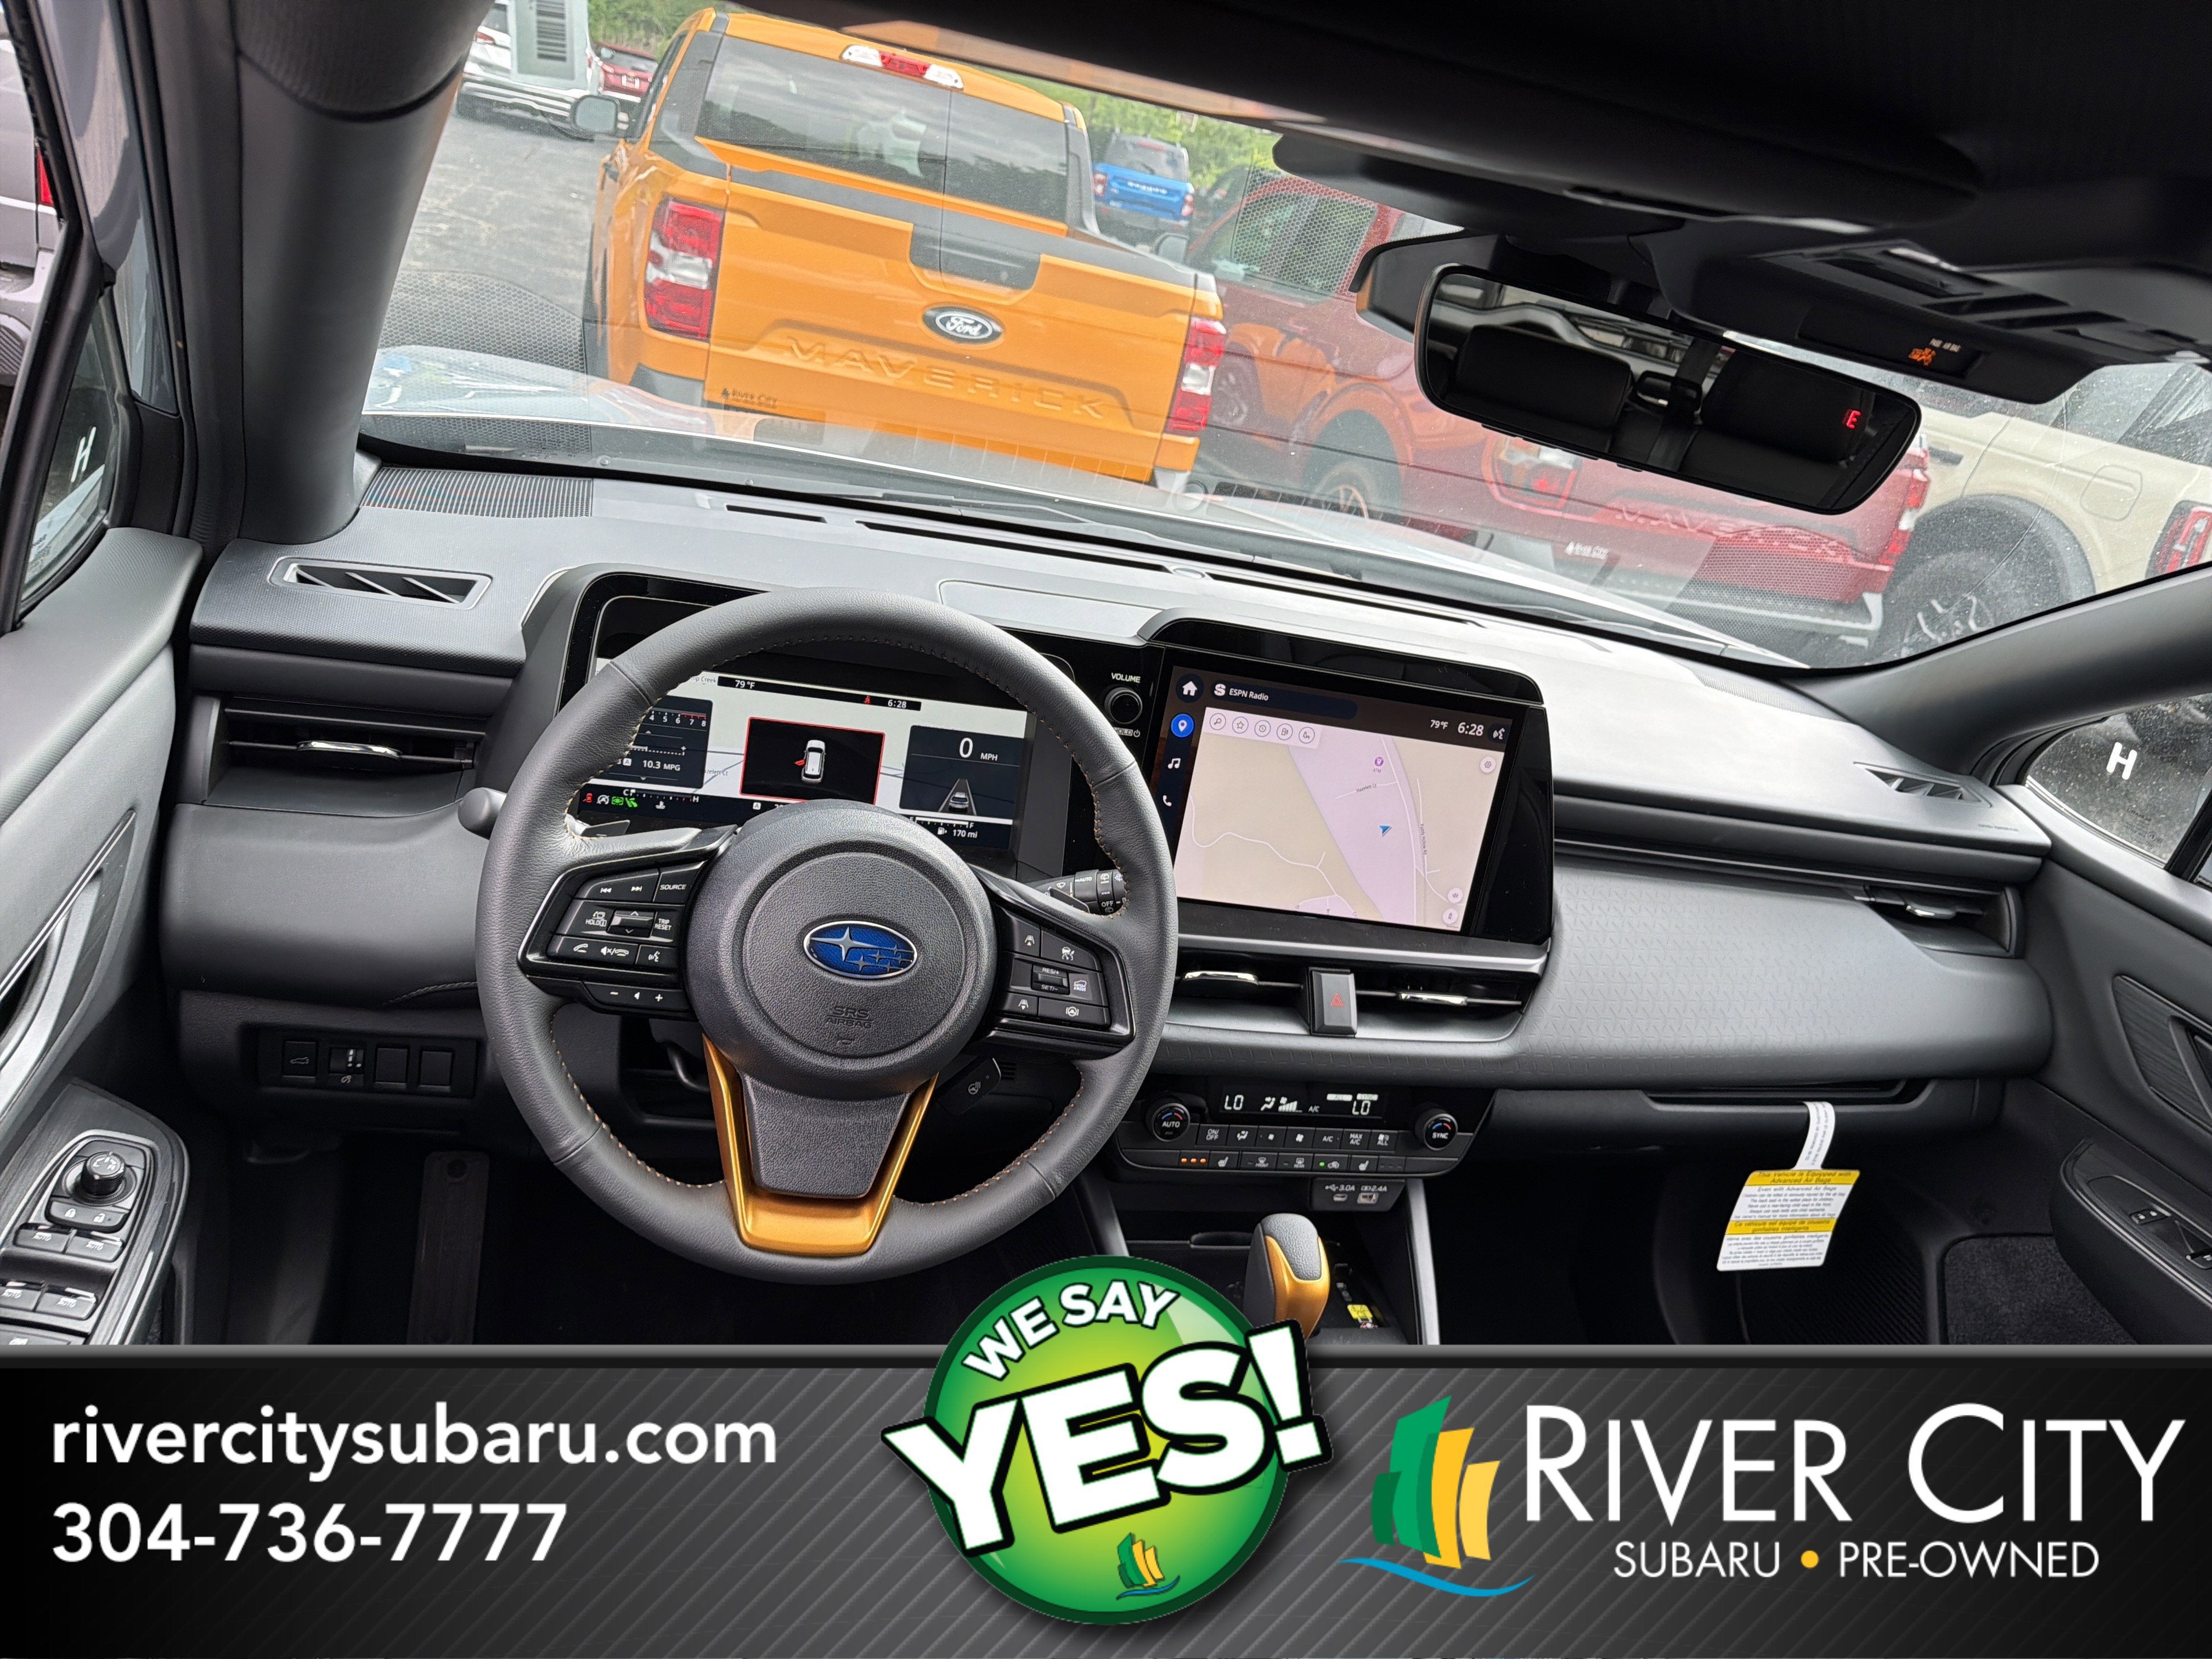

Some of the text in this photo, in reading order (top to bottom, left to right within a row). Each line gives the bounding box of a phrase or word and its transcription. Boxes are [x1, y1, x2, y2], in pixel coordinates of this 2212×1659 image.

[946, 316, 981, 336] Ford
[787, 336, 1105, 419] MAVERICK
[1846, 410, 1861, 428] E
[1111, 672, 1141, 684] VOLUME
[1229, 688, 1248, 698] ESPN
[1249, 691, 1269, 701] Radio
[888, 699, 907, 708] 6:28
[1458, 722, 1484, 736] 6:28
[960, 737, 973, 758] 0
[980, 752, 998, 761] MPH
[2106, 742, 2138, 780] H
[642, 760, 661, 769] 10.3
[663, 763, 680, 771] MPG
[953, 829, 978, 839] 170 mi
[832, 1007, 869, 1018] SRS
[826, 1017, 873, 1029] AIRBAG
[1224, 1094, 1244, 1110] LO
[1352, 1100, 1371, 1115] LO
